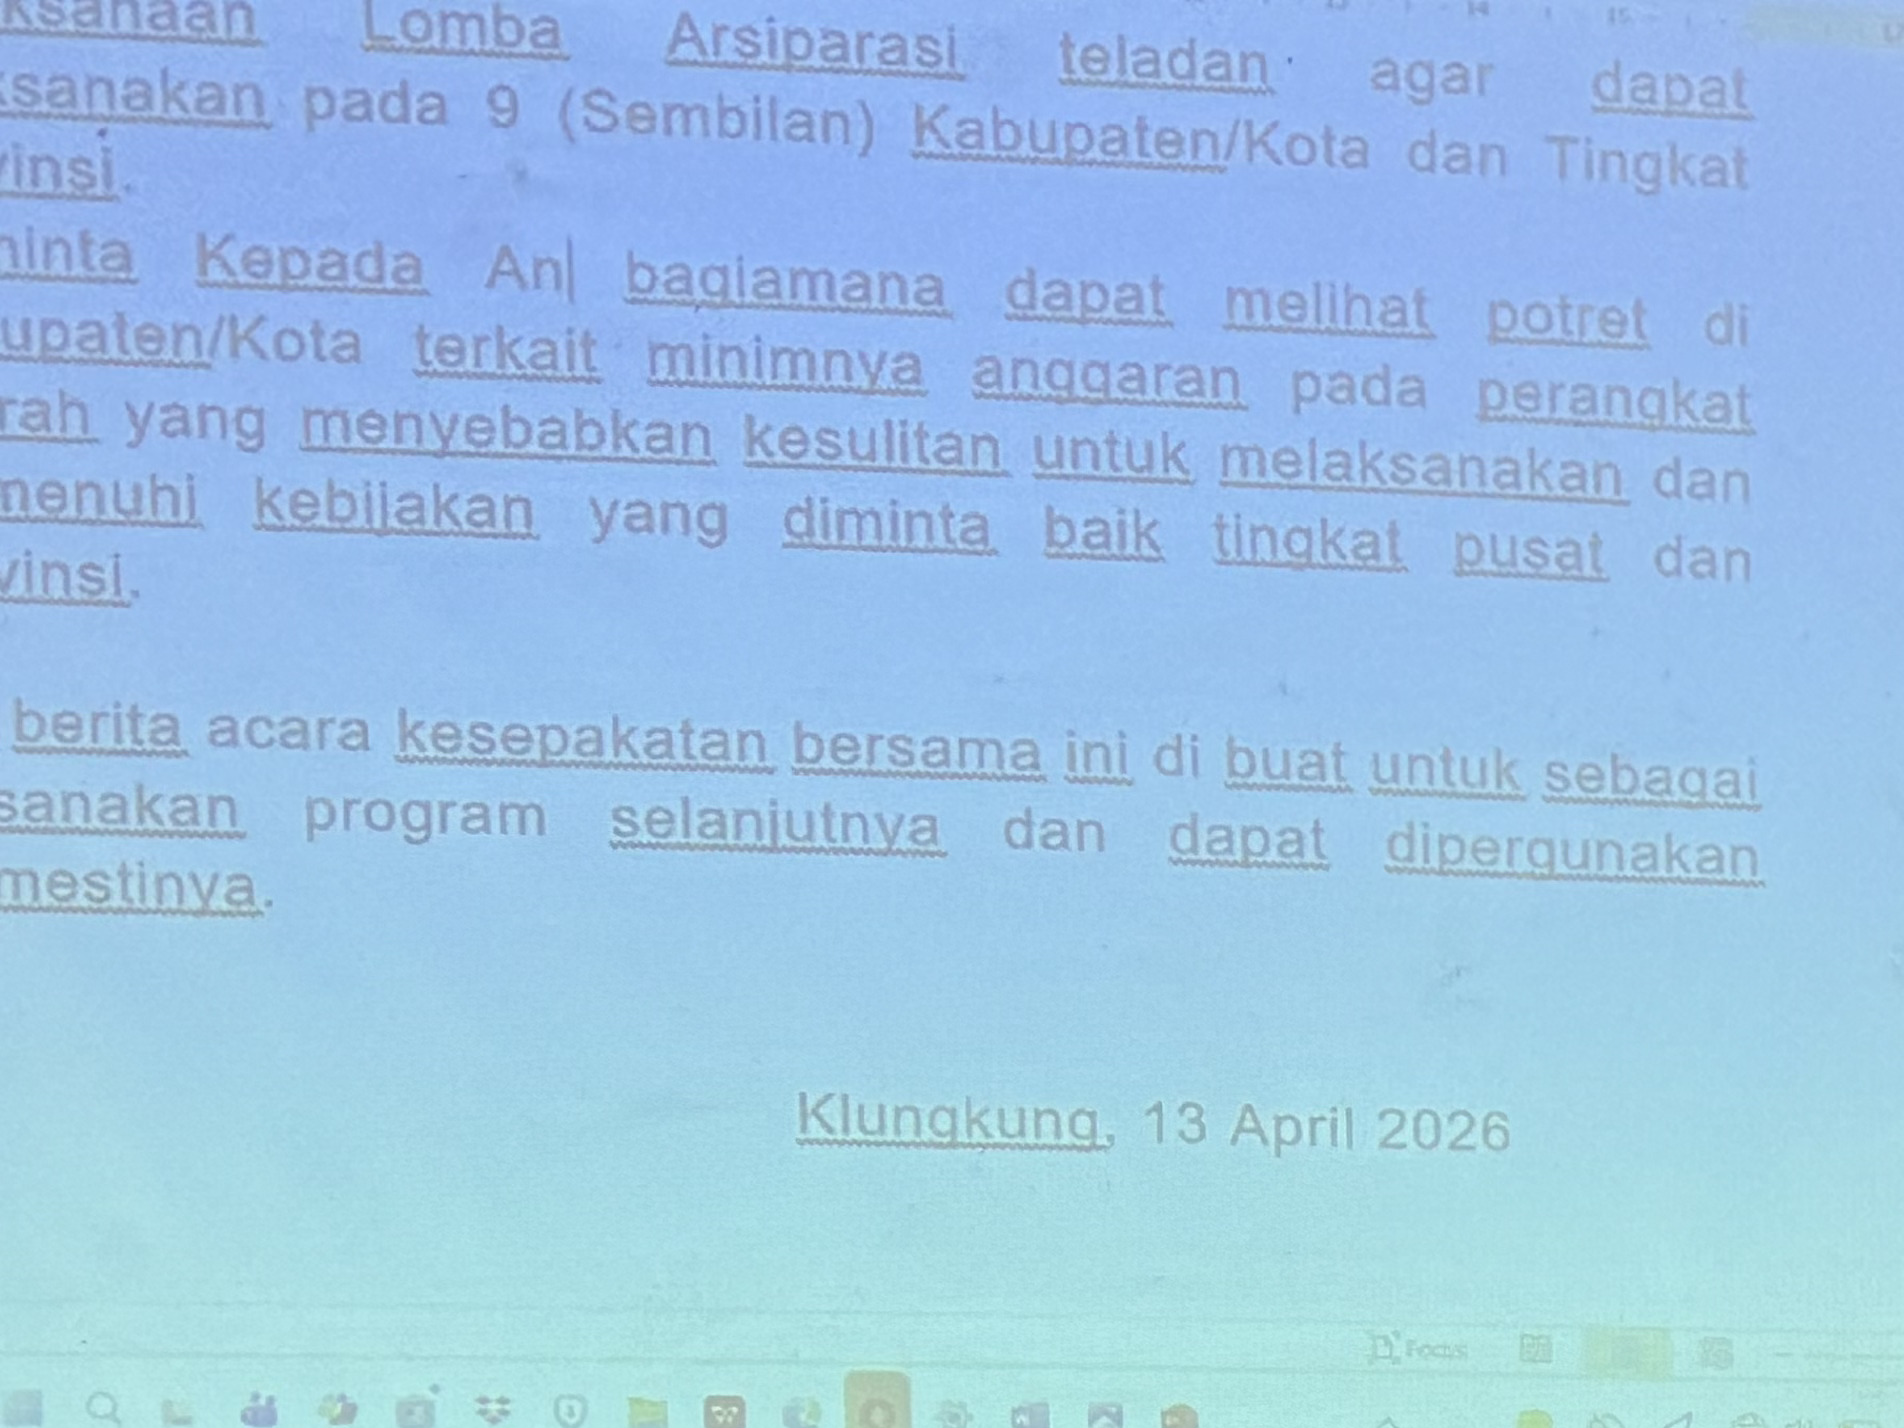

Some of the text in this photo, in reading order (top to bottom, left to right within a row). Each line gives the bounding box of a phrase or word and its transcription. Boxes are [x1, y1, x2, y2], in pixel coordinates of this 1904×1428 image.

[364, 0, 562, 51] Lomba
[669, 11, 957, 70] Arsiparasi
[1060, 31, 1268, 85] teladan
[1371, 53, 1495, 105] agar
[1593, 61, 1748, 115] dapat
[0, 66, 1748, 195] sanakan pada 9 (Sembilan) Kabupaten/Kota dan Tingkat
[198, 232, 424, 289] Kepada
[627, 251, 944, 306] bagiamana
[1005, 270, 1166, 320] dapat
[1226, 283, 1430, 332] melihat
[1487, 295, 1648, 344] potret
[1706, 303, 1748, 347] di
[2, 311, 1749, 430] upaten/Kota terkait minimnya anggaran pada perangkat
[125, 402, 265, 452] yang
[303, 408, 711, 457] menyebabkan
[746, 414, 1000, 467] kesulitan
[1033, 430, 1189, 475] untuk
[1222, 439, 1621, 496] melaksanakan
[1654, 459, 1749, 502] dan
[256, 476, 534, 533] kebijakan
[591, 498, 728, 547] yang
[785, 498, 990, 549] diminta
[1046, 508, 1160, 555] baik
[1214, 514, 1401, 566] tingkat
[1455, 530, 1603, 577] pusat
[1654, 539, 1751, 582] dan
[14, 699, 1759, 805] berita acara kesepakatan bersama ini di buat untuk sebagai
[305, 791, 545, 845] program
[612, 799, 939, 852] selanjutnya
[1004, 809, 1105, 852] dan
[1170, 813, 1327, 864] dapat
[1386, 821, 1759, 880] dipergunakan
[798, 1092, 1511, 1157] Klungkung, 13 April 2026
